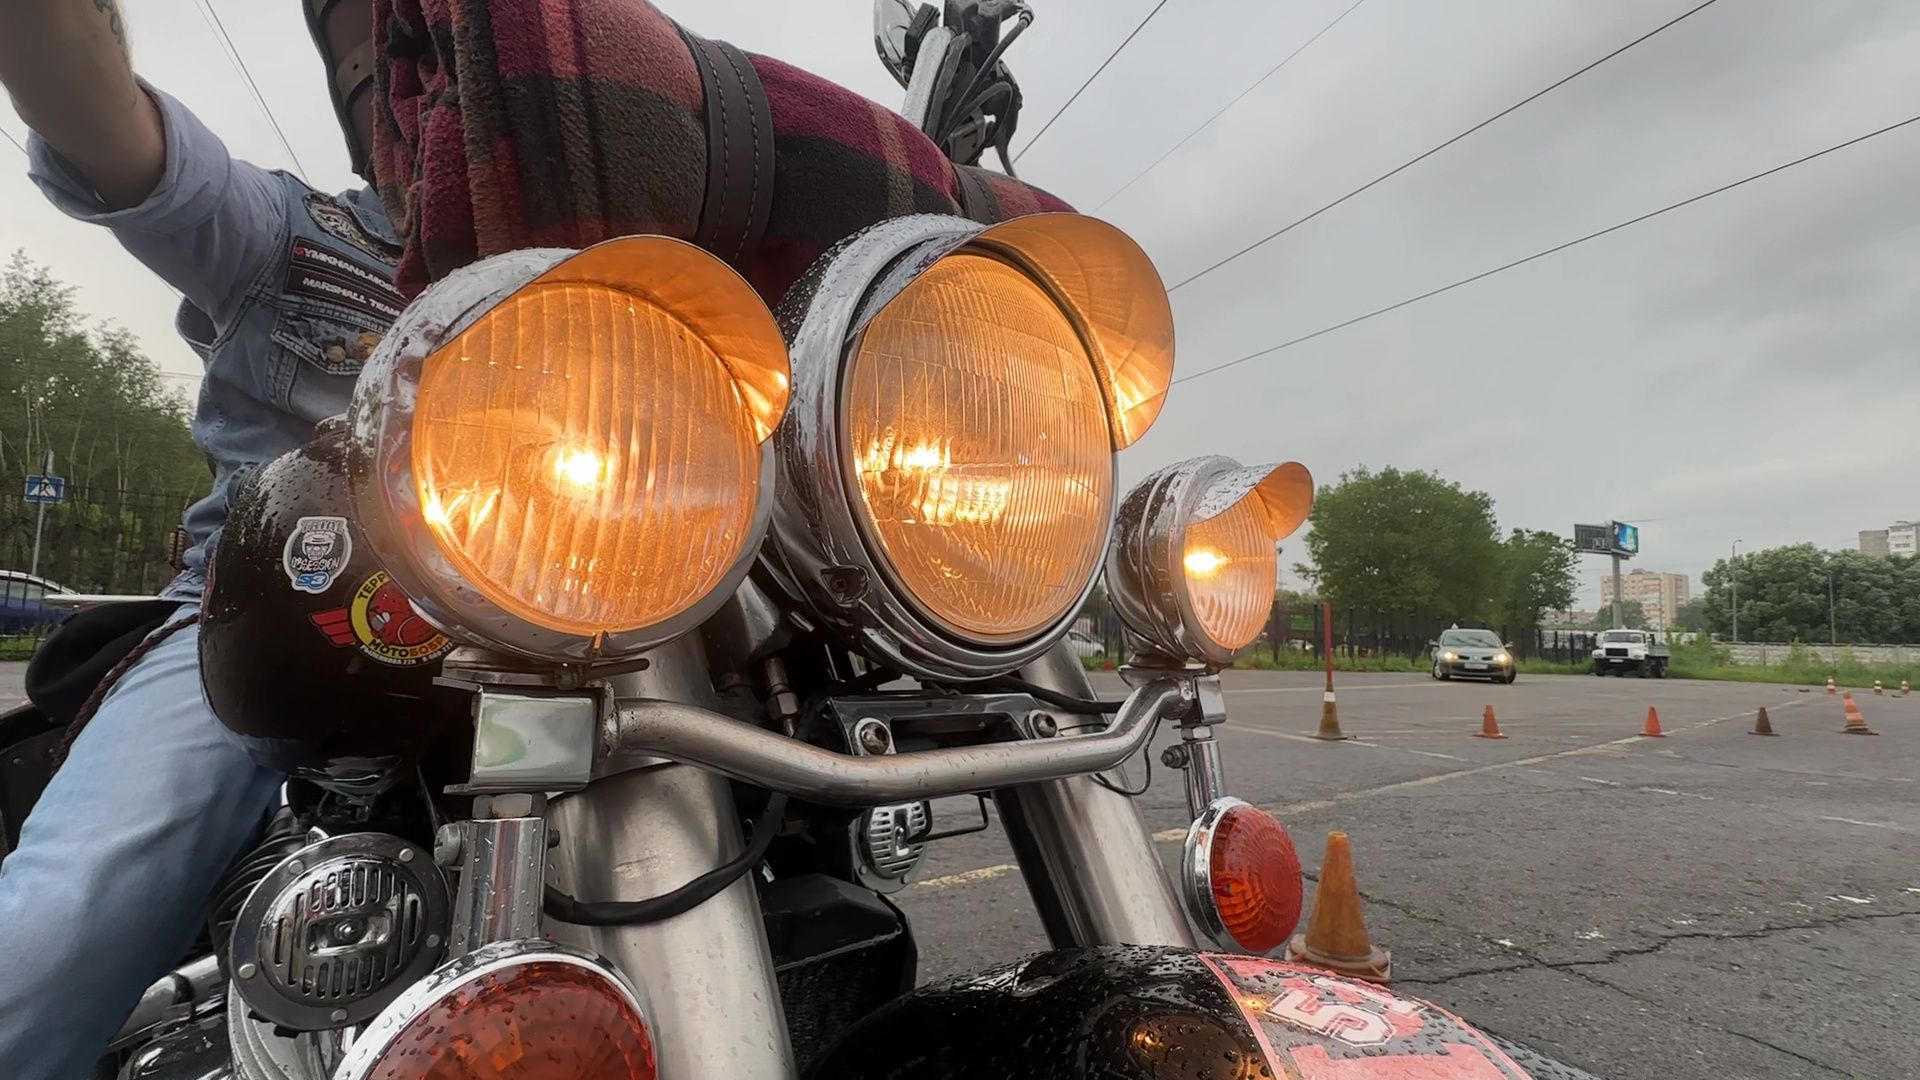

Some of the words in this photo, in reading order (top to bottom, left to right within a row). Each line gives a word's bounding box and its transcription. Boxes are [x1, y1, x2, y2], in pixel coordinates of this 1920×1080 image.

[302, 277, 367, 304] MARSHALL
[369, 298, 400, 317] TEAM
[301, 520, 346, 533] TRIAL
[291, 556, 340, 571] OBSESSION
[357, 573, 386, 600] ТЕРР
